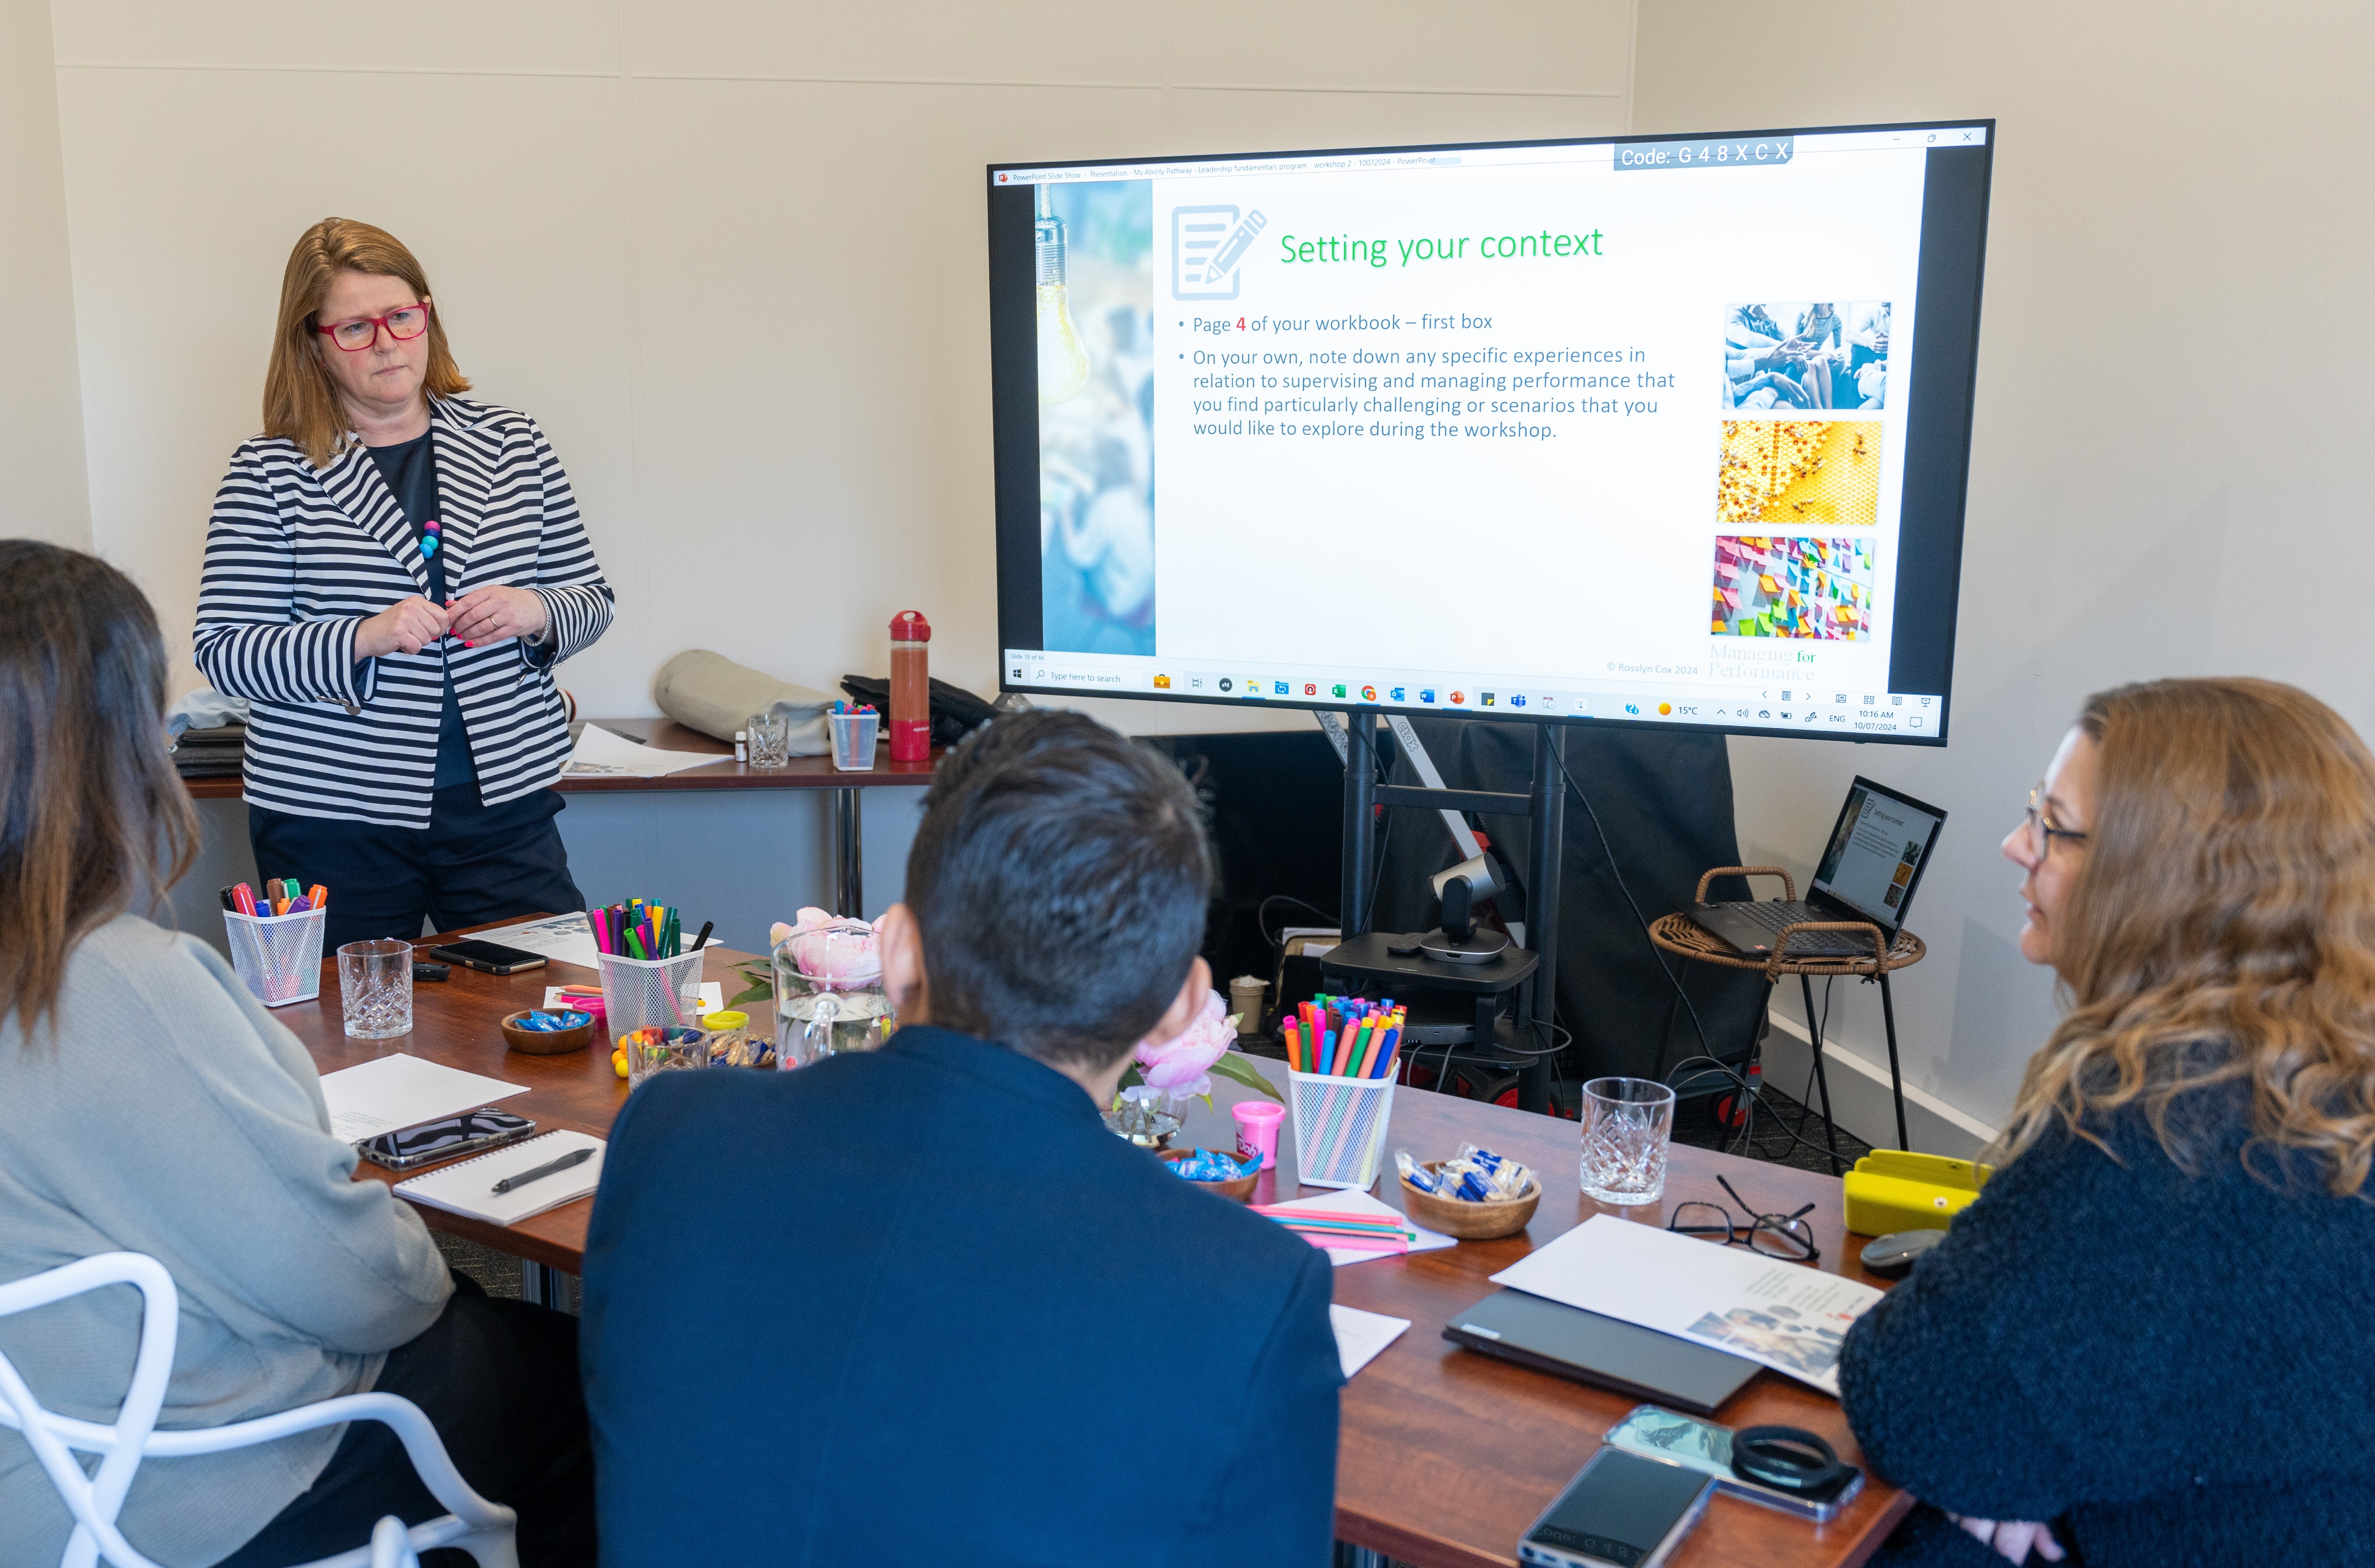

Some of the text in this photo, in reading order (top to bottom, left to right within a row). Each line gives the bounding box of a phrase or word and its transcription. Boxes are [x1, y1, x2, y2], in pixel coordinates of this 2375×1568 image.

[1621, 142, 1789, 166] Code: G 4 8 X C X
[1013, 173, 1046, 181] PowerPoint
[1134, 169, 1143, 177] My
[1358, 158, 1390, 166] 10072024
[1397, 157, 1436, 165] PowerPoint
[1280, 228, 1604, 269] Setting your context
[1194, 317, 1230, 335] Page
[1236, 317, 1246, 331] 4
[1251, 315, 1268, 331] of
[1272, 319, 1310, 335] your
[1315, 314, 1400, 331] workbook
[1421, 313, 1455, 329] first
[1461, 312, 1492, 329] box
[1193, 346, 1645, 368] On your own, note down any specific experiences in
[1194, 371, 1675, 392] relation to supervising and managing performance that
[1192, 396, 1657, 417] you find particularly challenging or scenarios that you
[1193, 419, 1556, 441] would like to explore during the workshop.
[1709, 643, 1816, 665] Managing for
[1050, 672, 1067, 681] Type
[1069, 672, 1086, 681] here
[1618, 663, 1653, 674] Rosslyn
[1655, 665, 1672, 674] Cox
[1675, 665, 1698, 675] 2024
[1708, 661, 1815, 681] Performance
[1678, 706, 1698, 715] 15°C
[1829, 714, 1845, 723] ENG
[1859, 710, 1879, 718] 10:16
[1855, 722, 1897, 731] 10/07/2024
